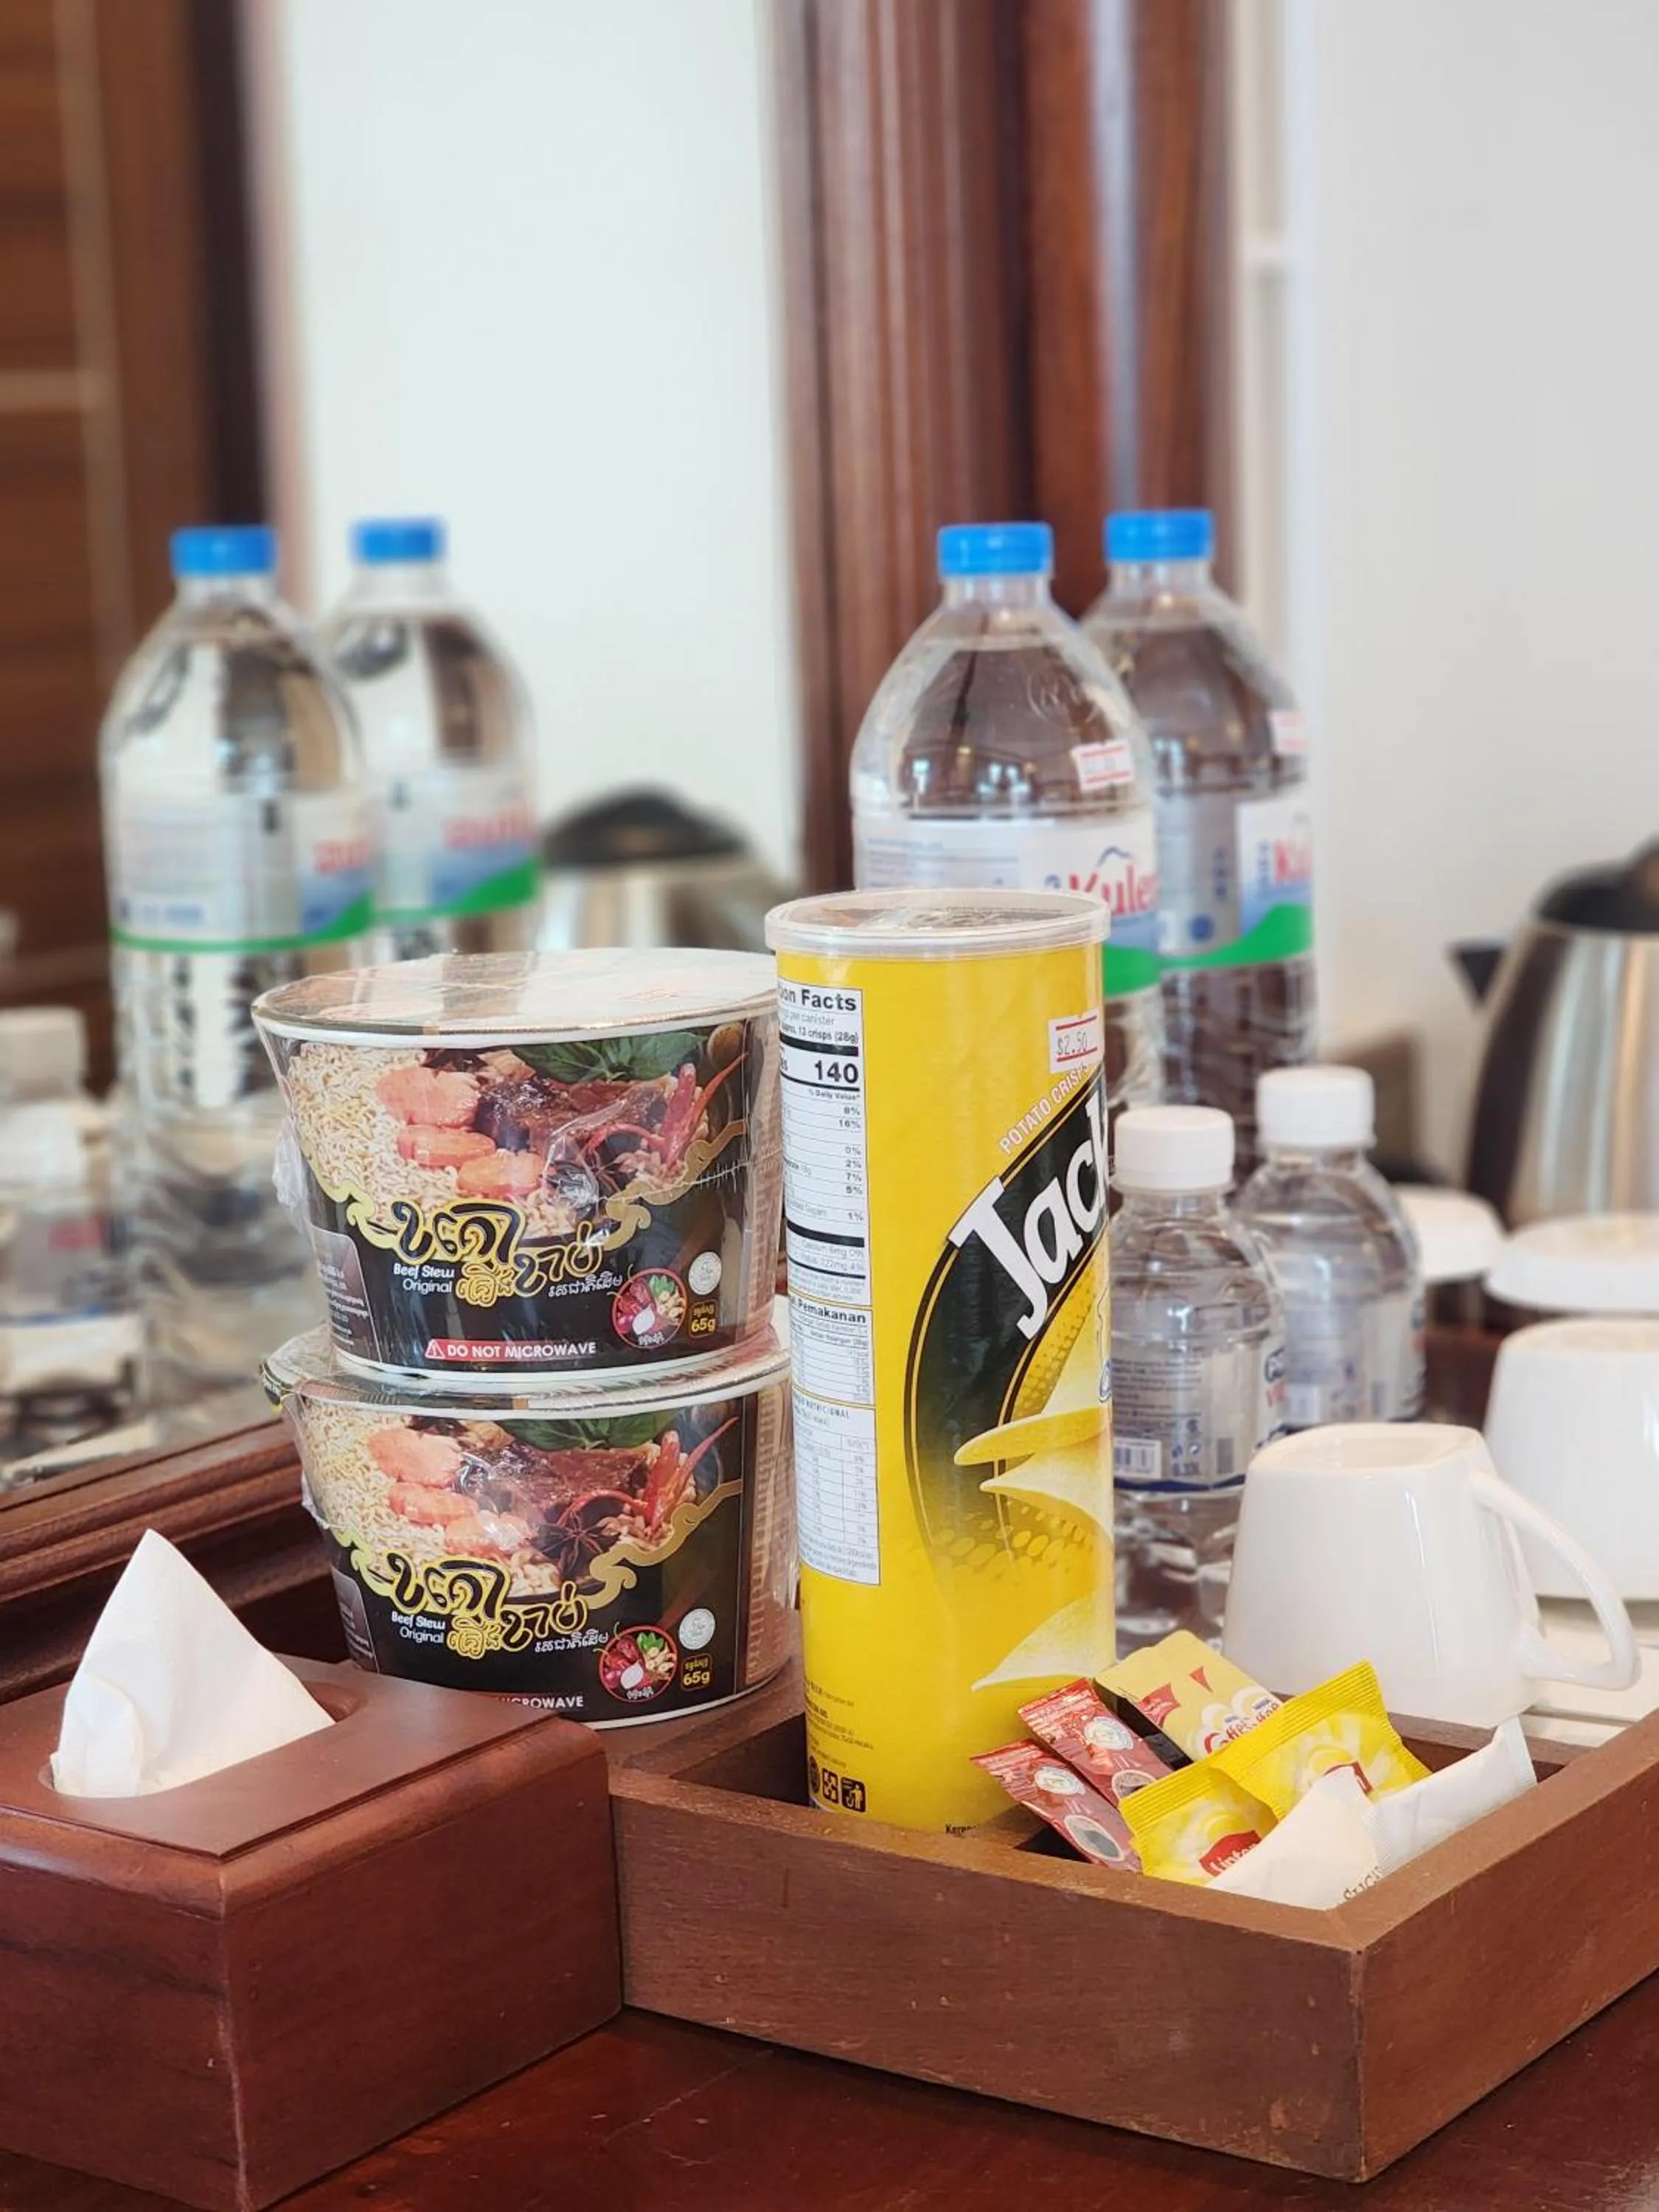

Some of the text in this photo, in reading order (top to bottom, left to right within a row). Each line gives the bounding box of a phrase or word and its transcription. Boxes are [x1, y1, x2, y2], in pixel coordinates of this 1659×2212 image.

[801, 989, 857, 1012] Facts
[808, 1029, 832, 1041] crisps
[834, 1031, 859, 1044] (28g)
[814, 1060, 859, 1084] 140
[815, 1089, 832, 1099] Daily
[1000, 1097, 1052, 1155] POTATO
[393, 1262, 455, 1279] Beef Stew
[402, 1278, 453, 1295] Original
[691, 1318, 717, 1333] 65g
[447, 1342, 597, 1359] DO NOT MICROWAVE
[392, 1610, 446, 1630] Beef Stew
[400, 1626, 445, 1644] Original
[684, 1670, 711, 1686] 65g
[498, 1695, 584, 1709] ROWAVE
[1208, 1843, 1257, 1874] Lipto
